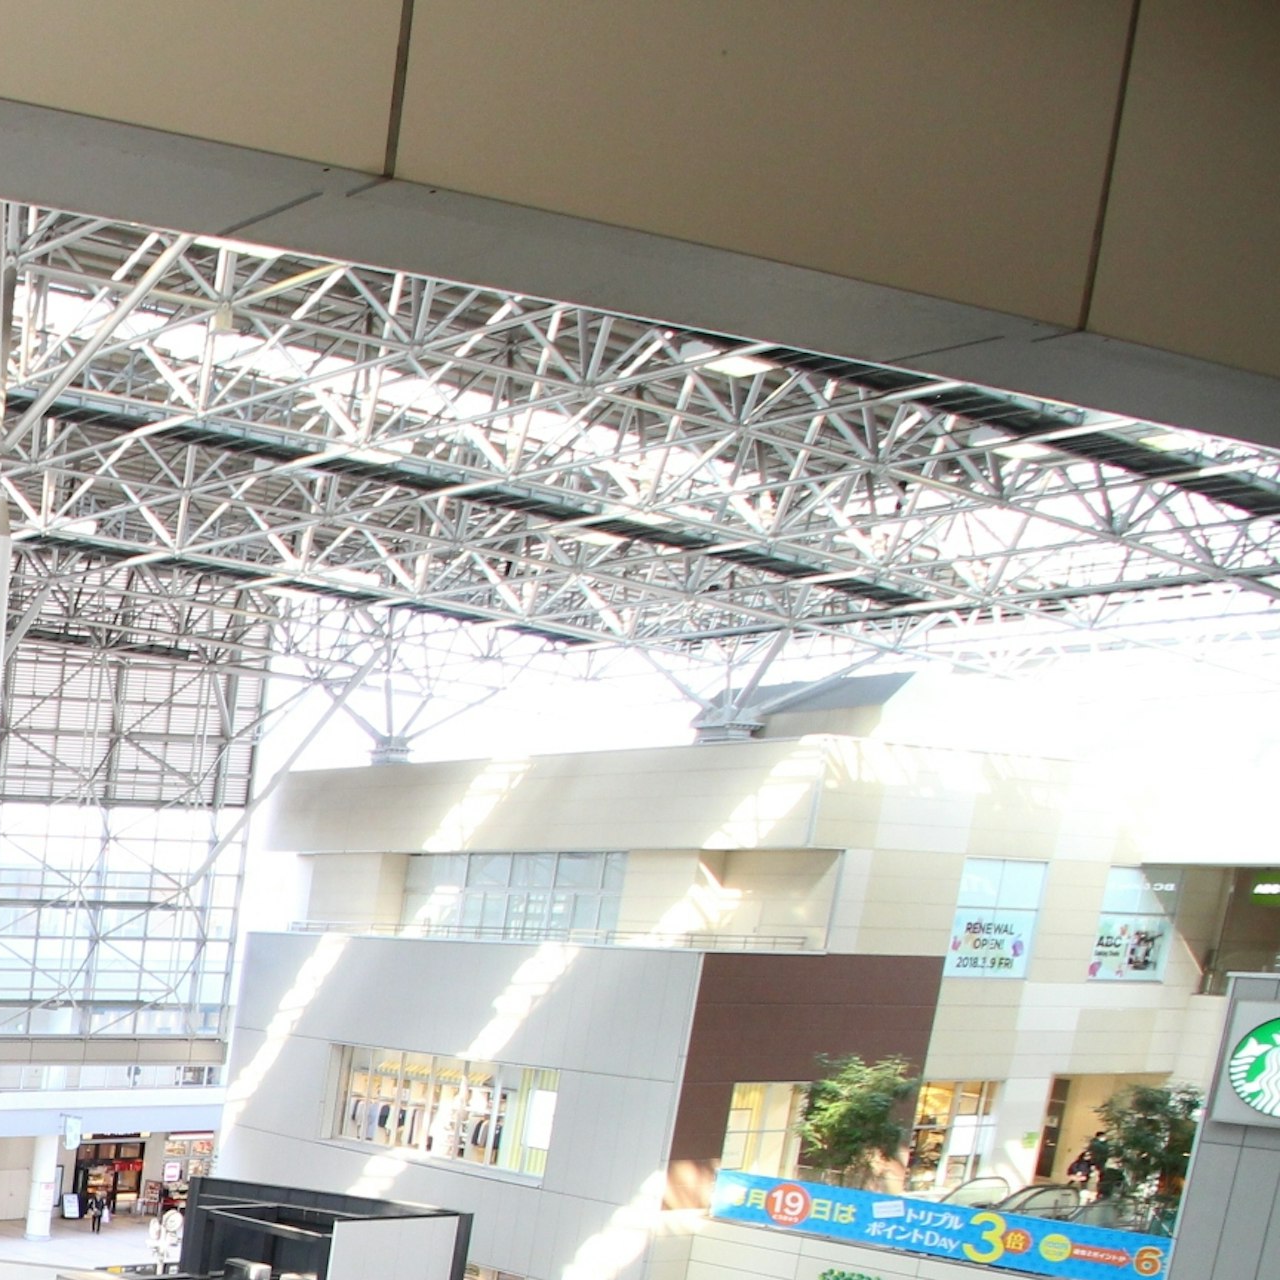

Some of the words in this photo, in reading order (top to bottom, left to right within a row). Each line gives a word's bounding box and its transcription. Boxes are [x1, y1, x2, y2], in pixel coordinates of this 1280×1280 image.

[965, 922, 1015, 935] RENEWAL
[972, 937, 1005, 950] OPEN!
[1096, 935, 1122, 948] ABC
[997, 957, 1013, 969] FRI
[906, 1209, 964, 1231] トリプル
